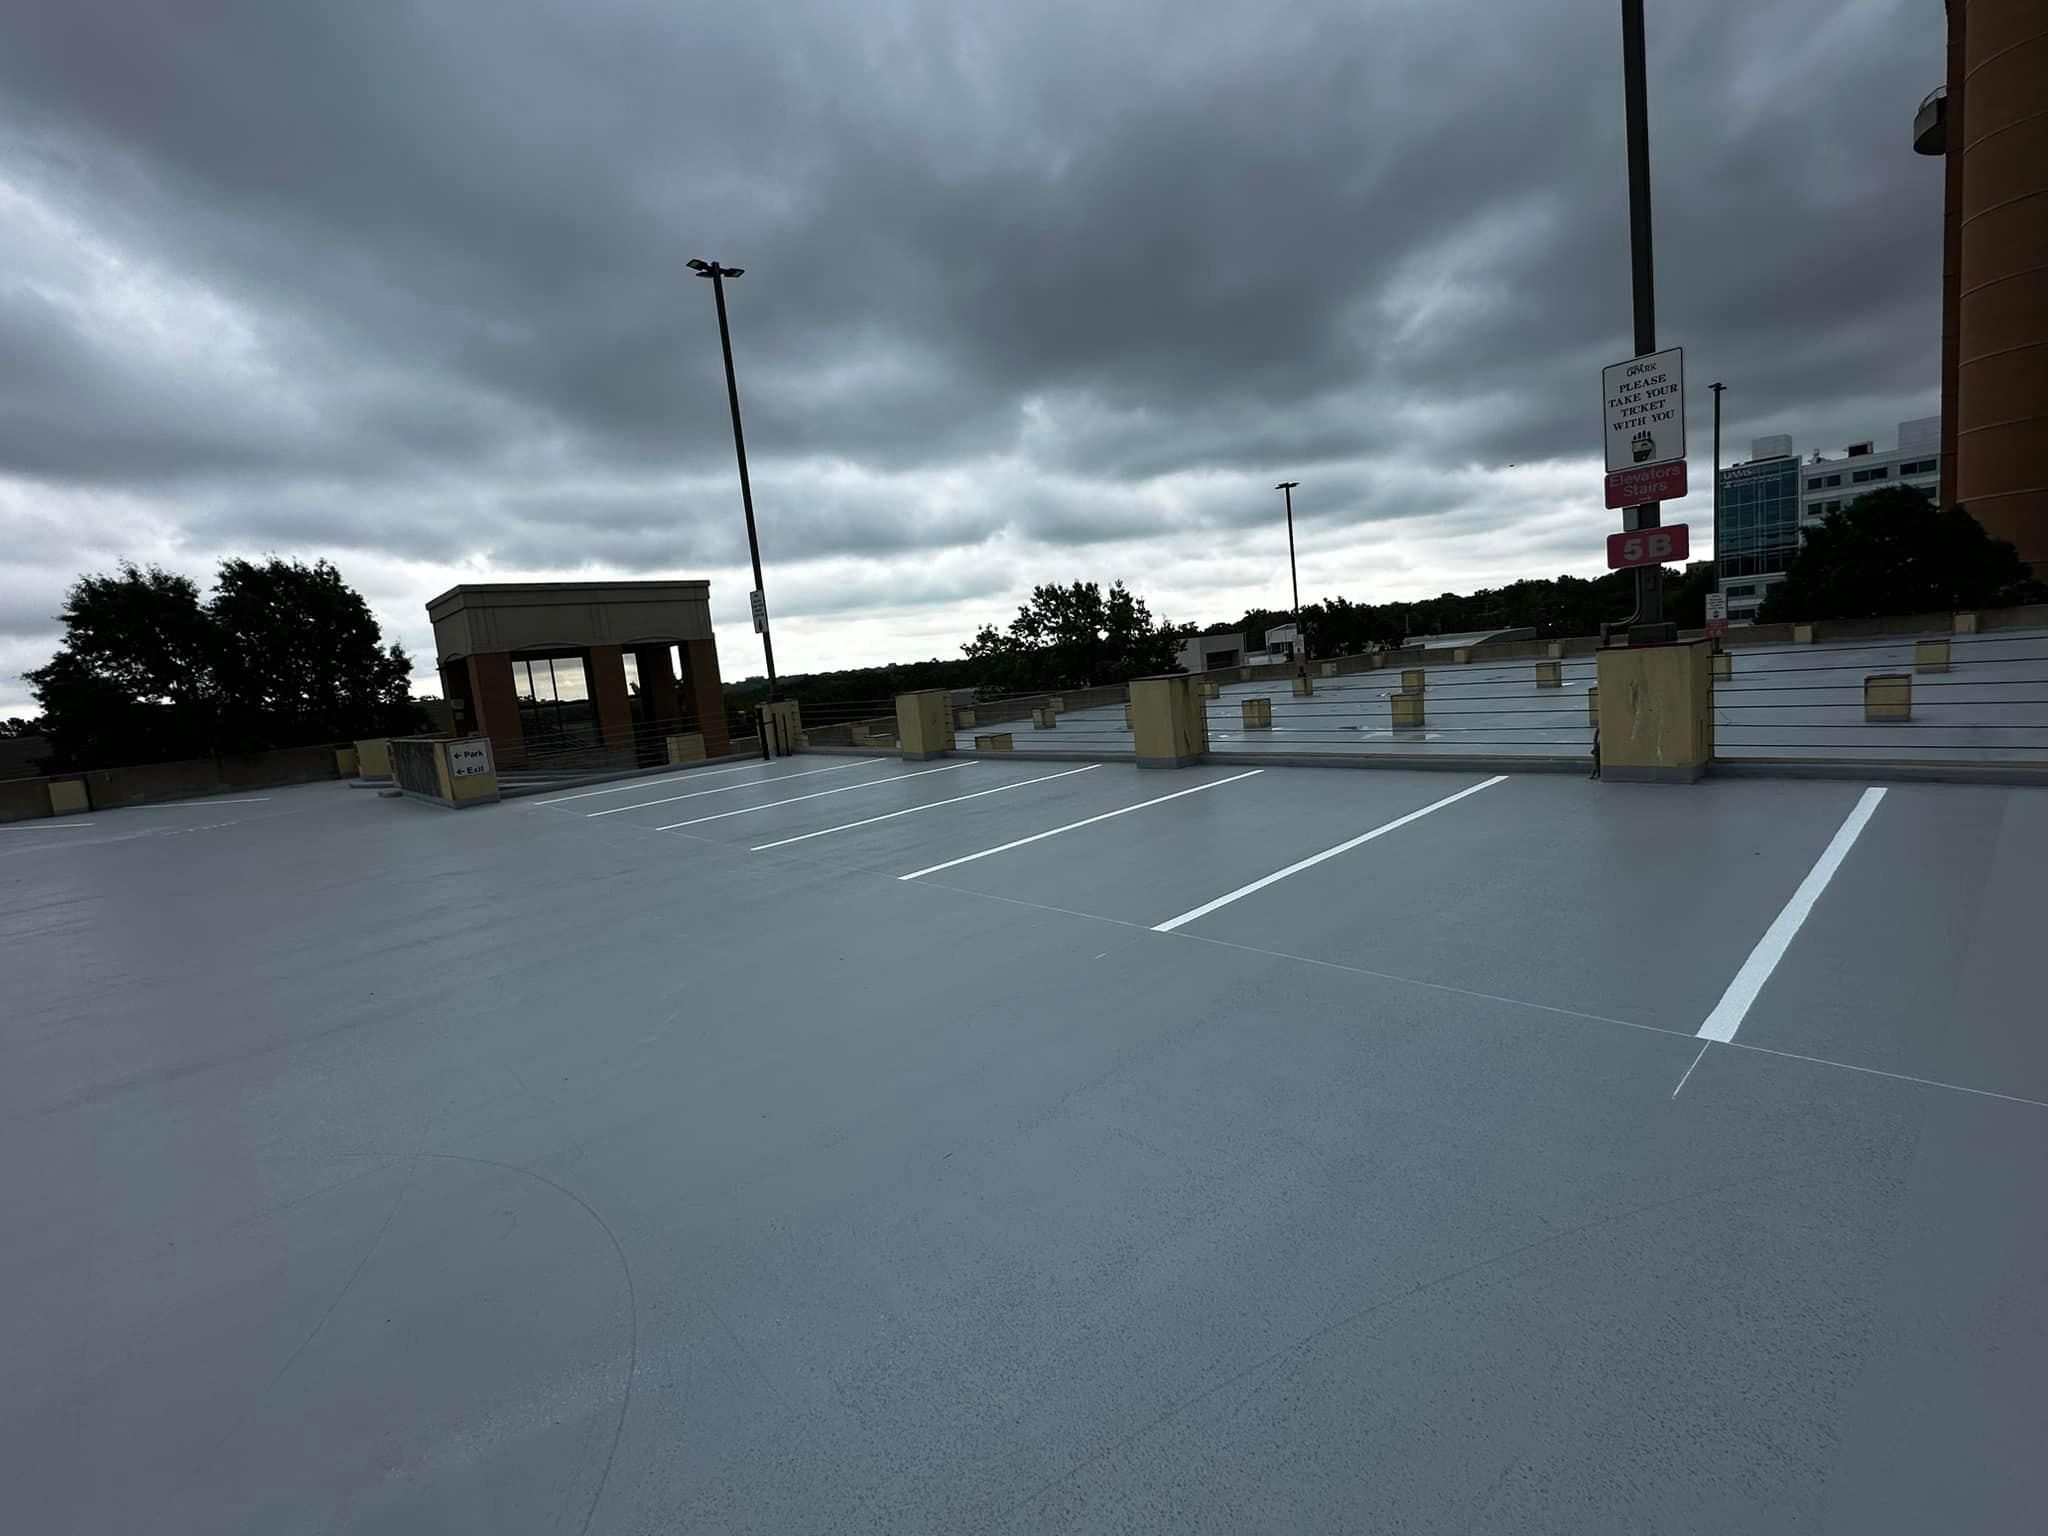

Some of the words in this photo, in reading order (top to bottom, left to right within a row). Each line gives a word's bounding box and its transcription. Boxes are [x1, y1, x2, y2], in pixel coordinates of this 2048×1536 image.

[1619, 374, 1667, 393] PLEASE
[1608, 393, 1641, 408] TAKE
[1646, 383, 1679, 399] YOUR
[1620, 399, 1666, 418] TICKET
[1613, 416, 1646, 432] WITH
[1651, 409, 1675, 422] YOU
[1609, 466, 1681, 487] Elevators
[1623, 481, 1668, 497] Stairs
[464, 750, 483, 758] Park
